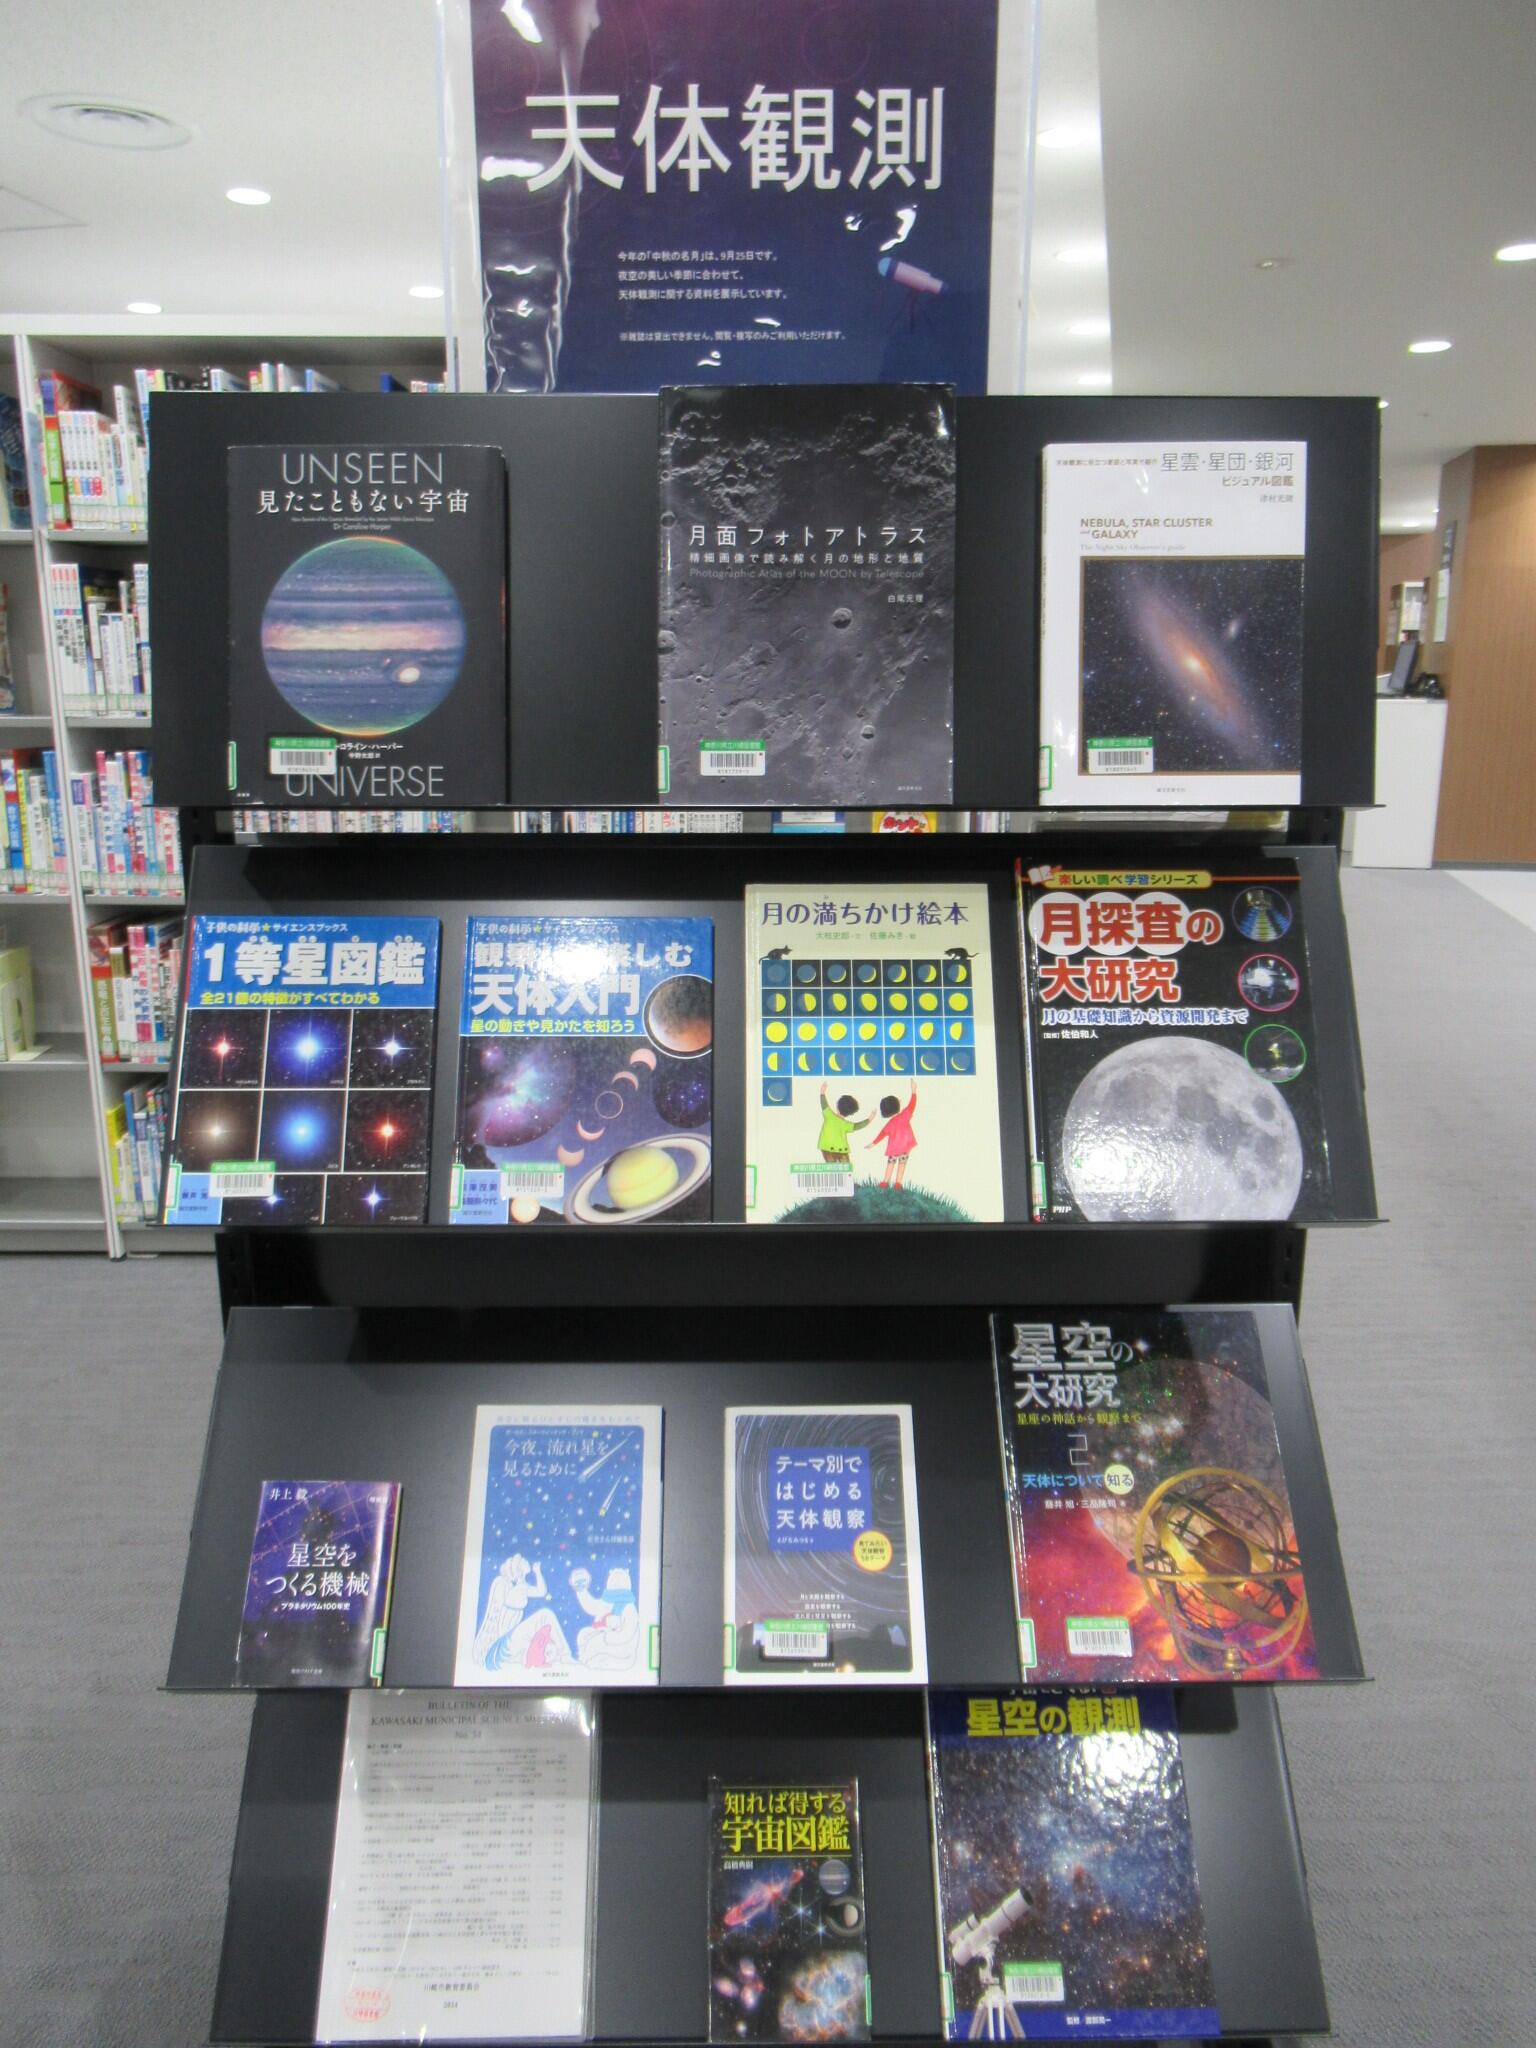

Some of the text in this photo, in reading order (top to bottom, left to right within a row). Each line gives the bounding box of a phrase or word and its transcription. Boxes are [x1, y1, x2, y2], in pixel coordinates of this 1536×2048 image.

[525, 83, 944, 193] 天体観測
[282, 453, 443, 485] UNSEEN
[1222, 475, 1294, 487] ビジュアル図鑑
[256, 489, 469, 514] 見たこともない宇宙
[689, 525, 926, 546] 月面フォトアトラス
[1080, 518, 1213, 529] NEBULA, STAR CLUSTER
[1091, 529, 1138, 539] GALAXY
[286, 766, 444, 796] UNIVERSE
[1059, 873, 1198, 886] 楽しい調べ学習シリーズ
[761, 901, 969, 926] 月の満ちかけ絵本
[1040, 901, 1222, 946] 月探査の
[204, 941, 426, 985] 1等星図鑑
[1040, 958, 1180, 1002] 大研究
[201, 991, 380, 1005] 全21個の特徴がすべてわかる
[471, 973, 641, 1016] 天体入門
[470, 1019, 635, 1034] 星の動きや見かたを知ろう
[1042, 1008, 1249, 1025] 月の基礎知識から資源開発まで
[1053, 1205, 1072, 1214] PHP
[1010, 1321, 1134, 1371] 星空の
[1014, 1373, 1121, 1409] 大研究
[503, 1460, 577, 1477] 見るために
[776, 1455, 863, 1473] テーマ別で
[776, 1482, 862, 1500] はじめる
[776, 1509, 865, 1529] 天体観察
[287, 1543, 357, 1567] 星空を
[266, 1571, 370, 1597] つくる機械
[967, 1696, 1141, 1736] 星空の観測
[724, 1791, 846, 1815] 知れば得する
[722, 1815, 850, 1853] 宇宙図鑑
